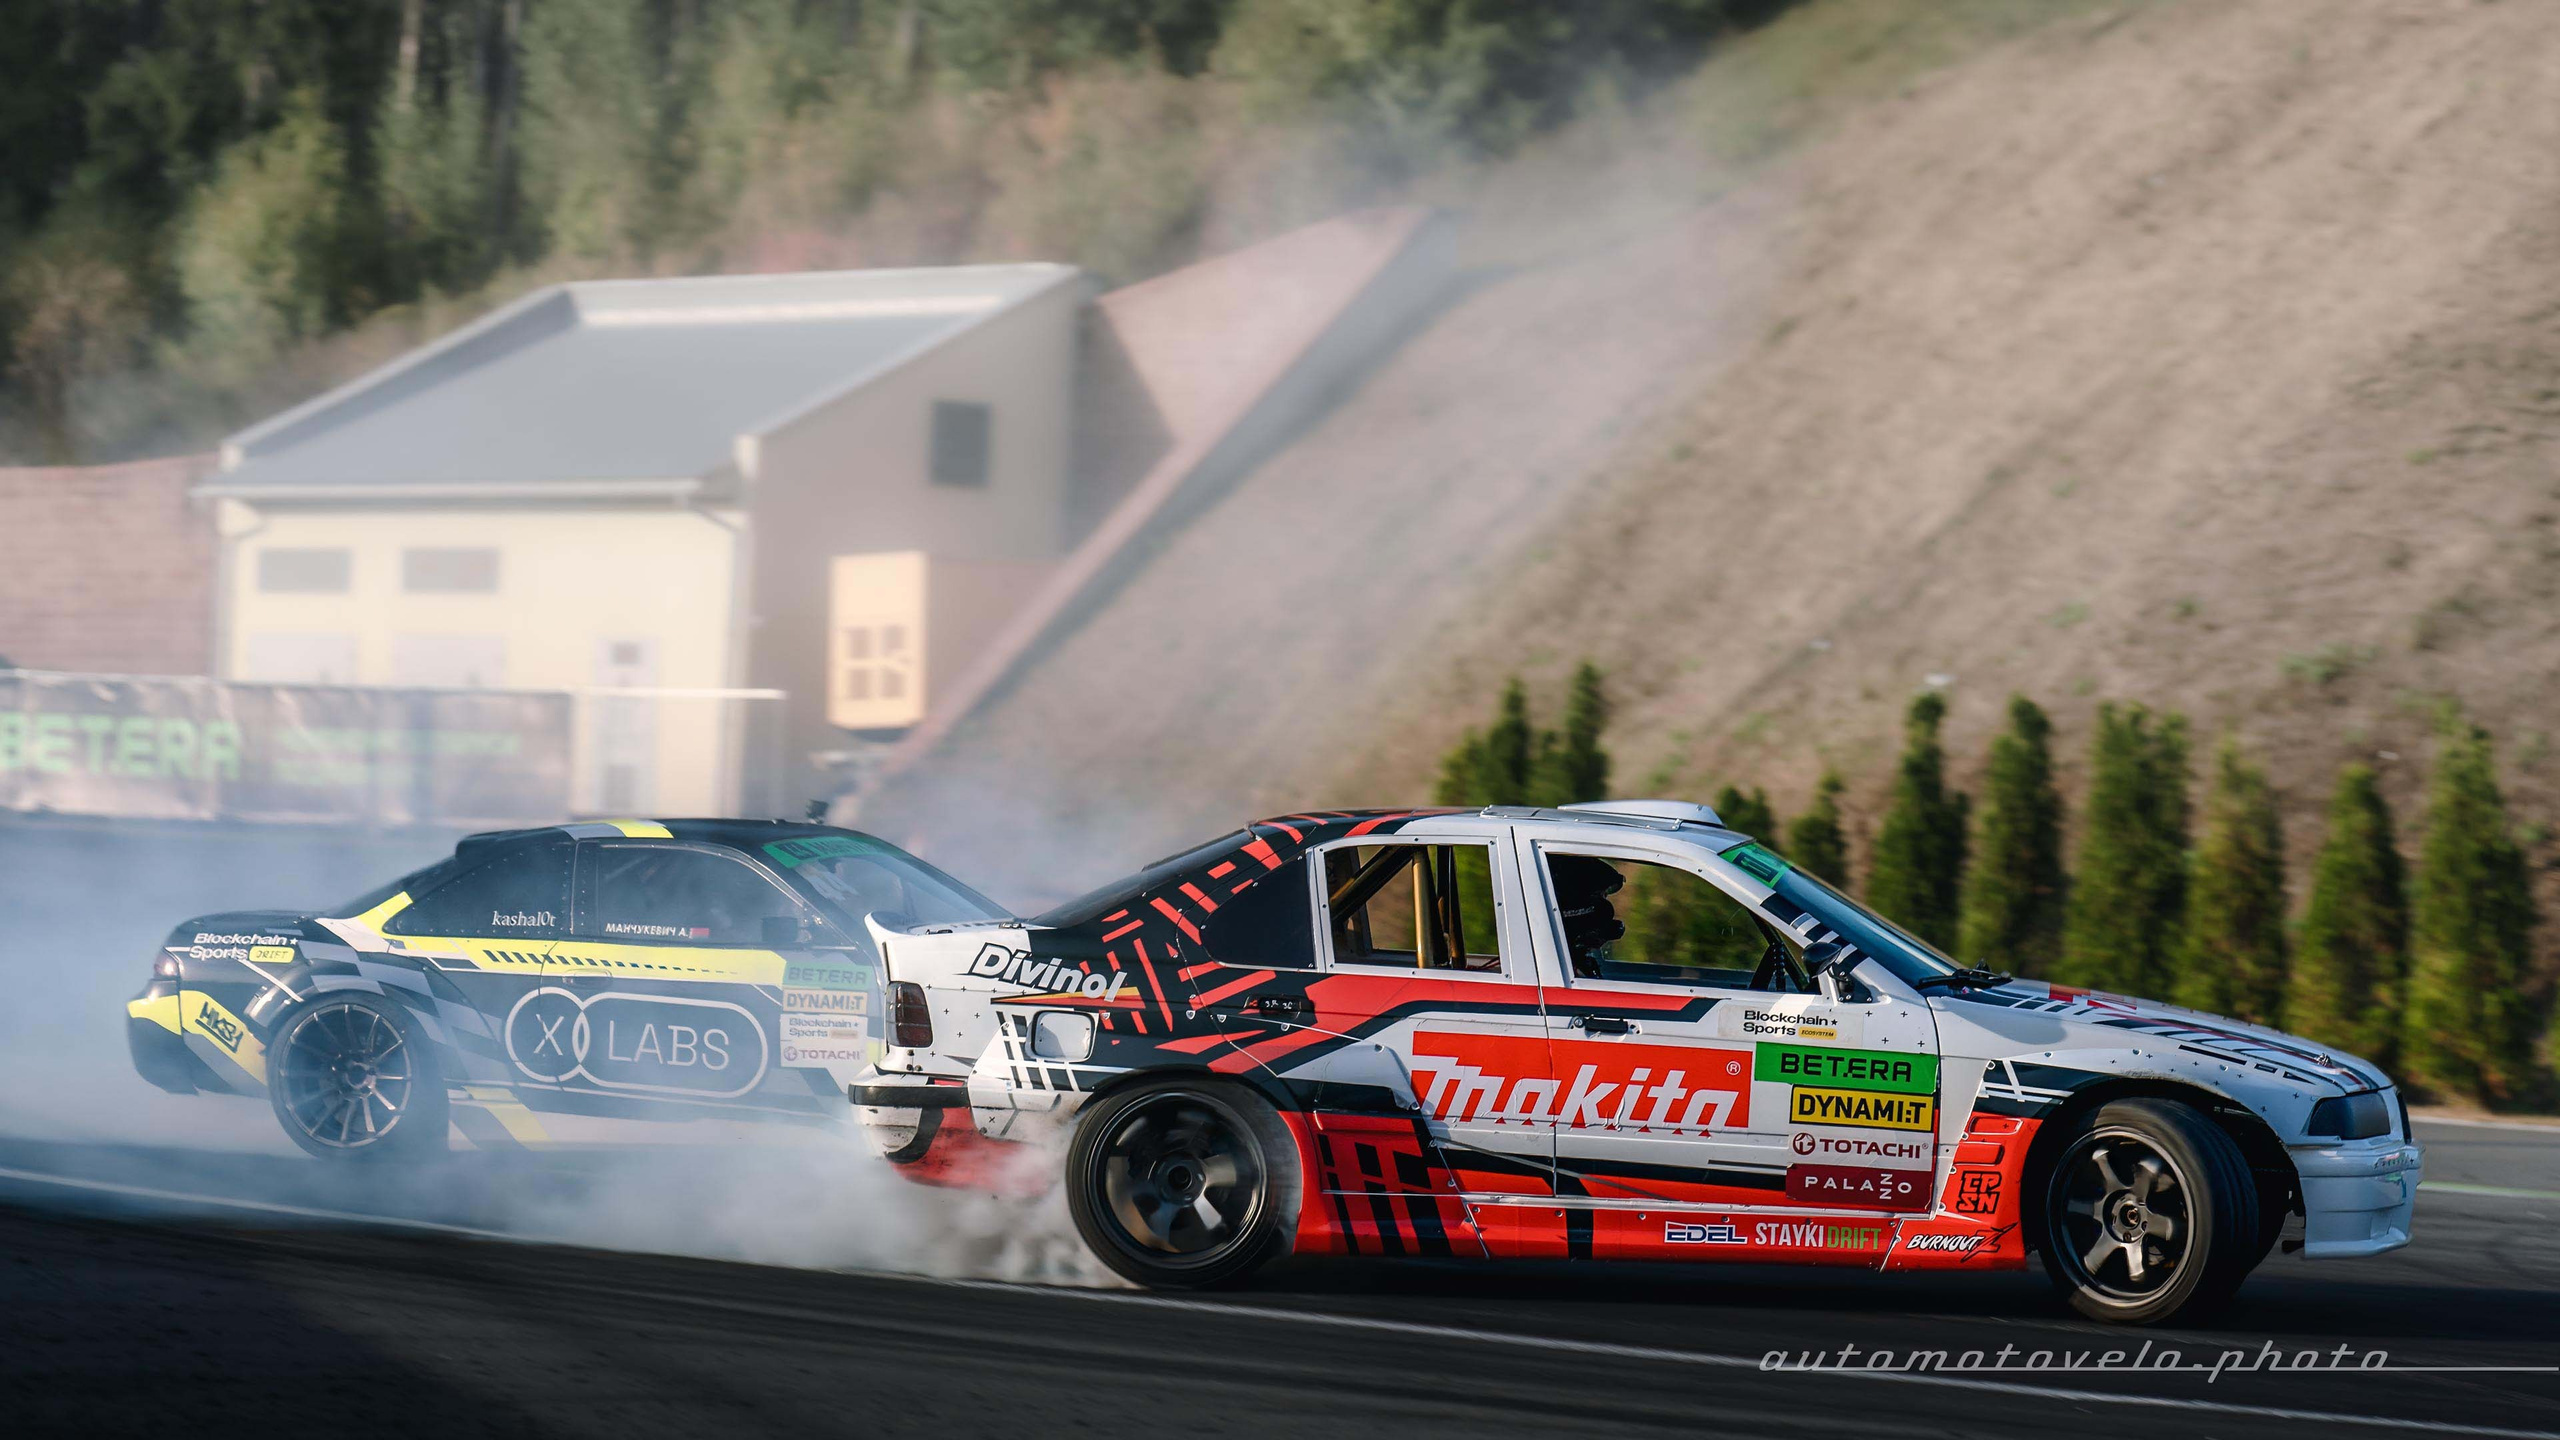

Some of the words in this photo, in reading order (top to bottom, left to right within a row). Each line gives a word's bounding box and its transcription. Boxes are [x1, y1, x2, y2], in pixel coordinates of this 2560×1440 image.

[606, 922, 676, 937] МАНЧУКЕВИЧ
[193, 932, 288, 946] Blockchain
[188, 945, 249, 961] Sports
[968, 942, 1127, 1002] Divinol
[789, 1018, 852, 1029] Blockchain
[1744, 1010, 1828, 1026] Blockchain
[788, 1027, 828, 1038] Sports
[1743, 1022, 1796, 1036] Sports
[533, 1013, 565, 1056] X
[608, 1019, 730, 1071] LABS
[799, 1049, 860, 1060] TOTACHI
[1819, 1138, 1921, 1159] TOTACHI
[1664, 1221, 1748, 1244] EDEL
[1906, 1233, 1985, 1252] BURNOUT
